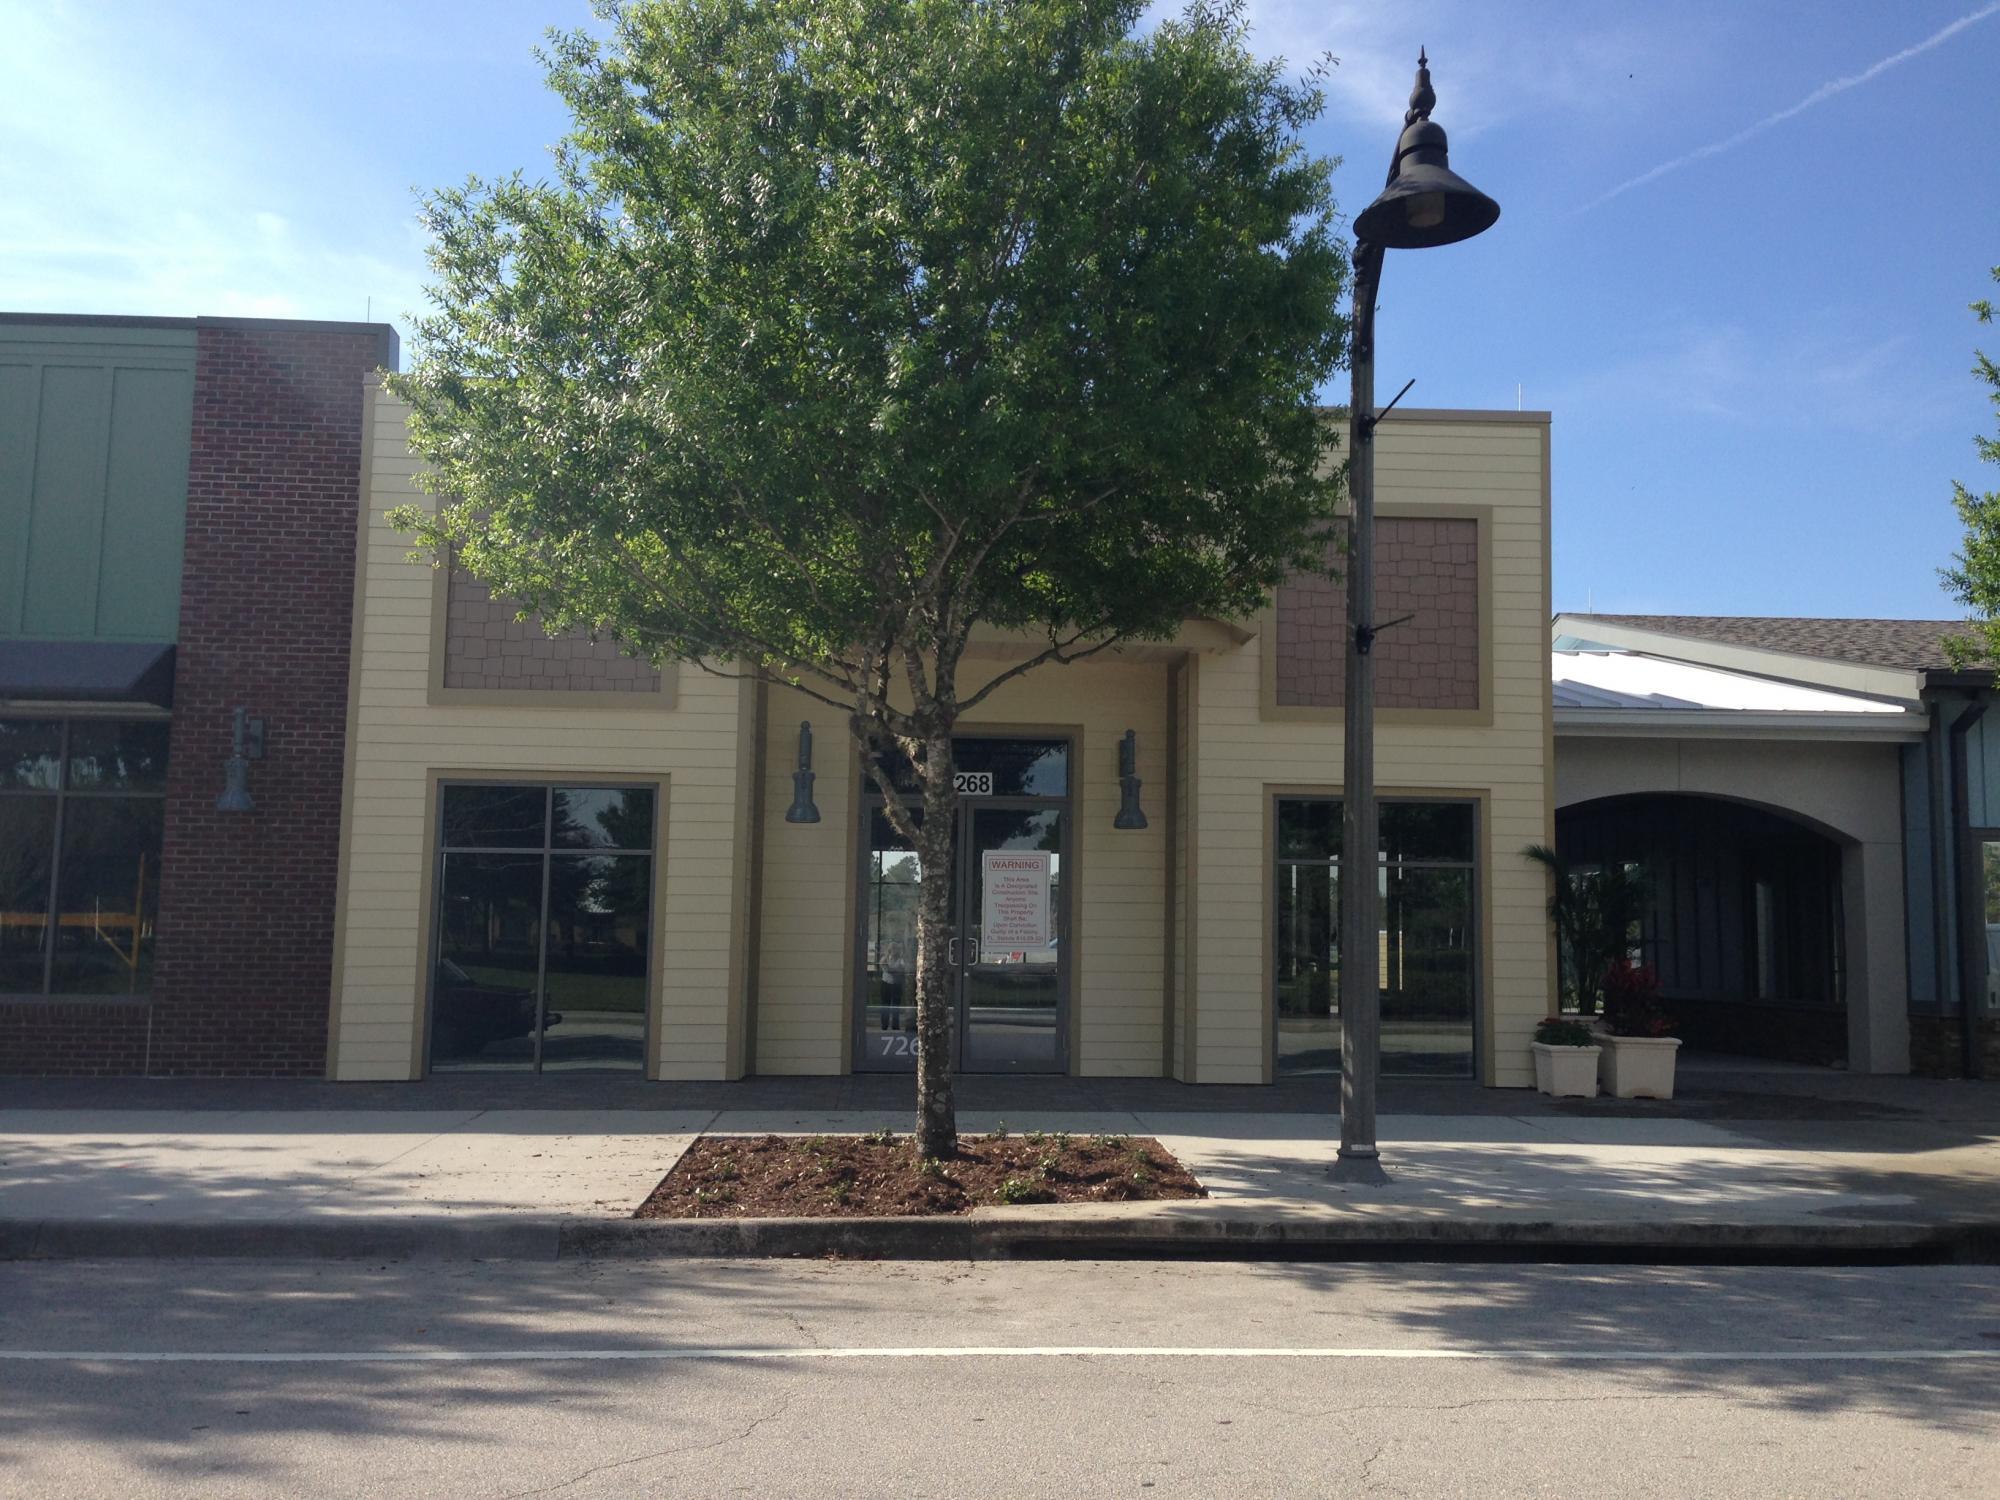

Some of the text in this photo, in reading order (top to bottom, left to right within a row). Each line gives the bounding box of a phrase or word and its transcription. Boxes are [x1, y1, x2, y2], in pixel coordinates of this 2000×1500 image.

[952, 774, 990, 793] 268
[991, 860, 1040, 869] WARNING
[880, 1036, 919, 1056] 726
